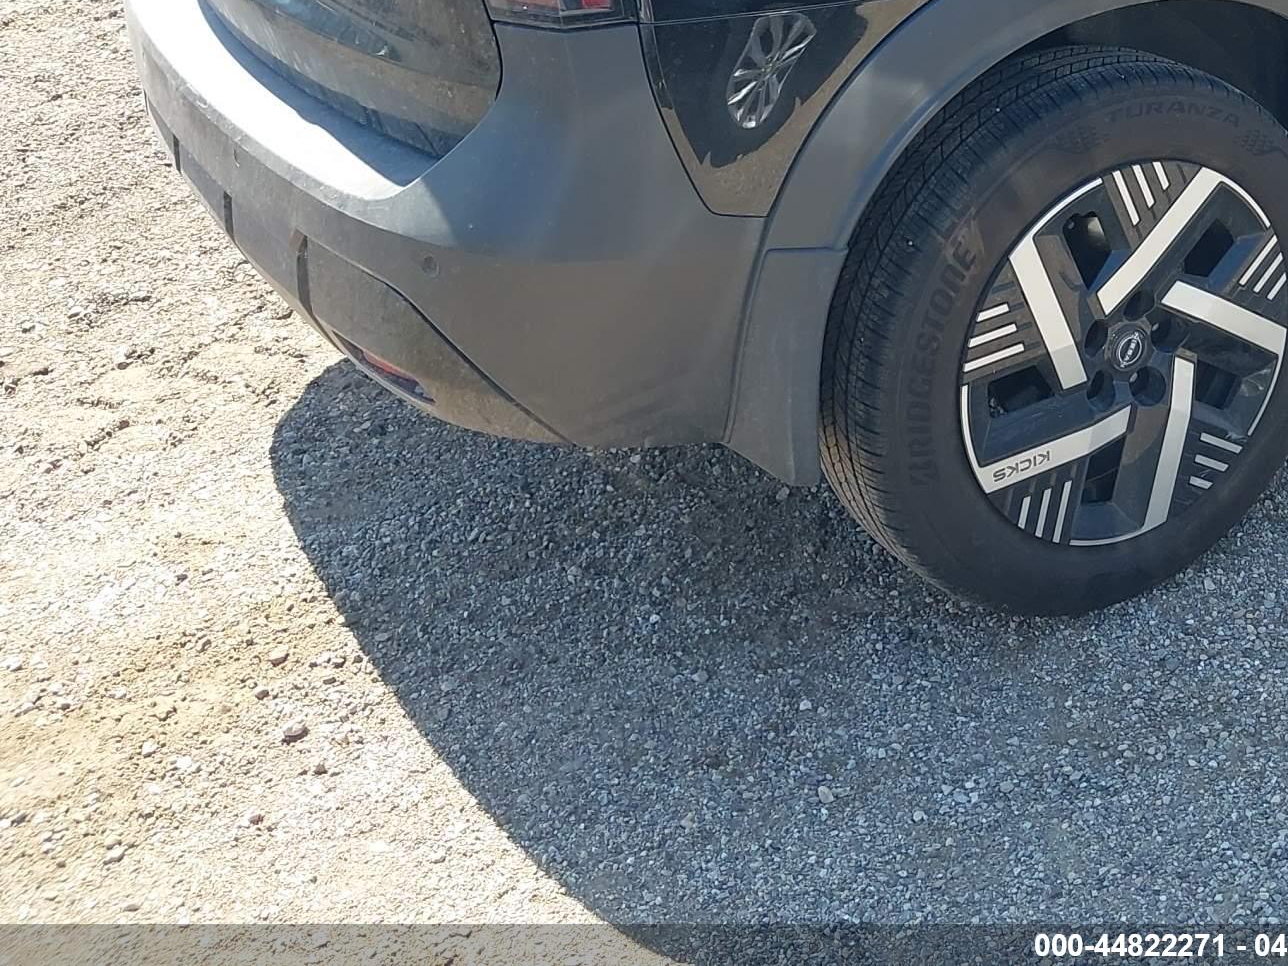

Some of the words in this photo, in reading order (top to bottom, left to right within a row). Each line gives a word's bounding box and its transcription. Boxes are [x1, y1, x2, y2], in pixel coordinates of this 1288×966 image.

[1104, 101, 1240, 129] TURANZA
[907, 240, 978, 486] BRIDGESTONE
[993, 450, 1050, 482] KICKS
